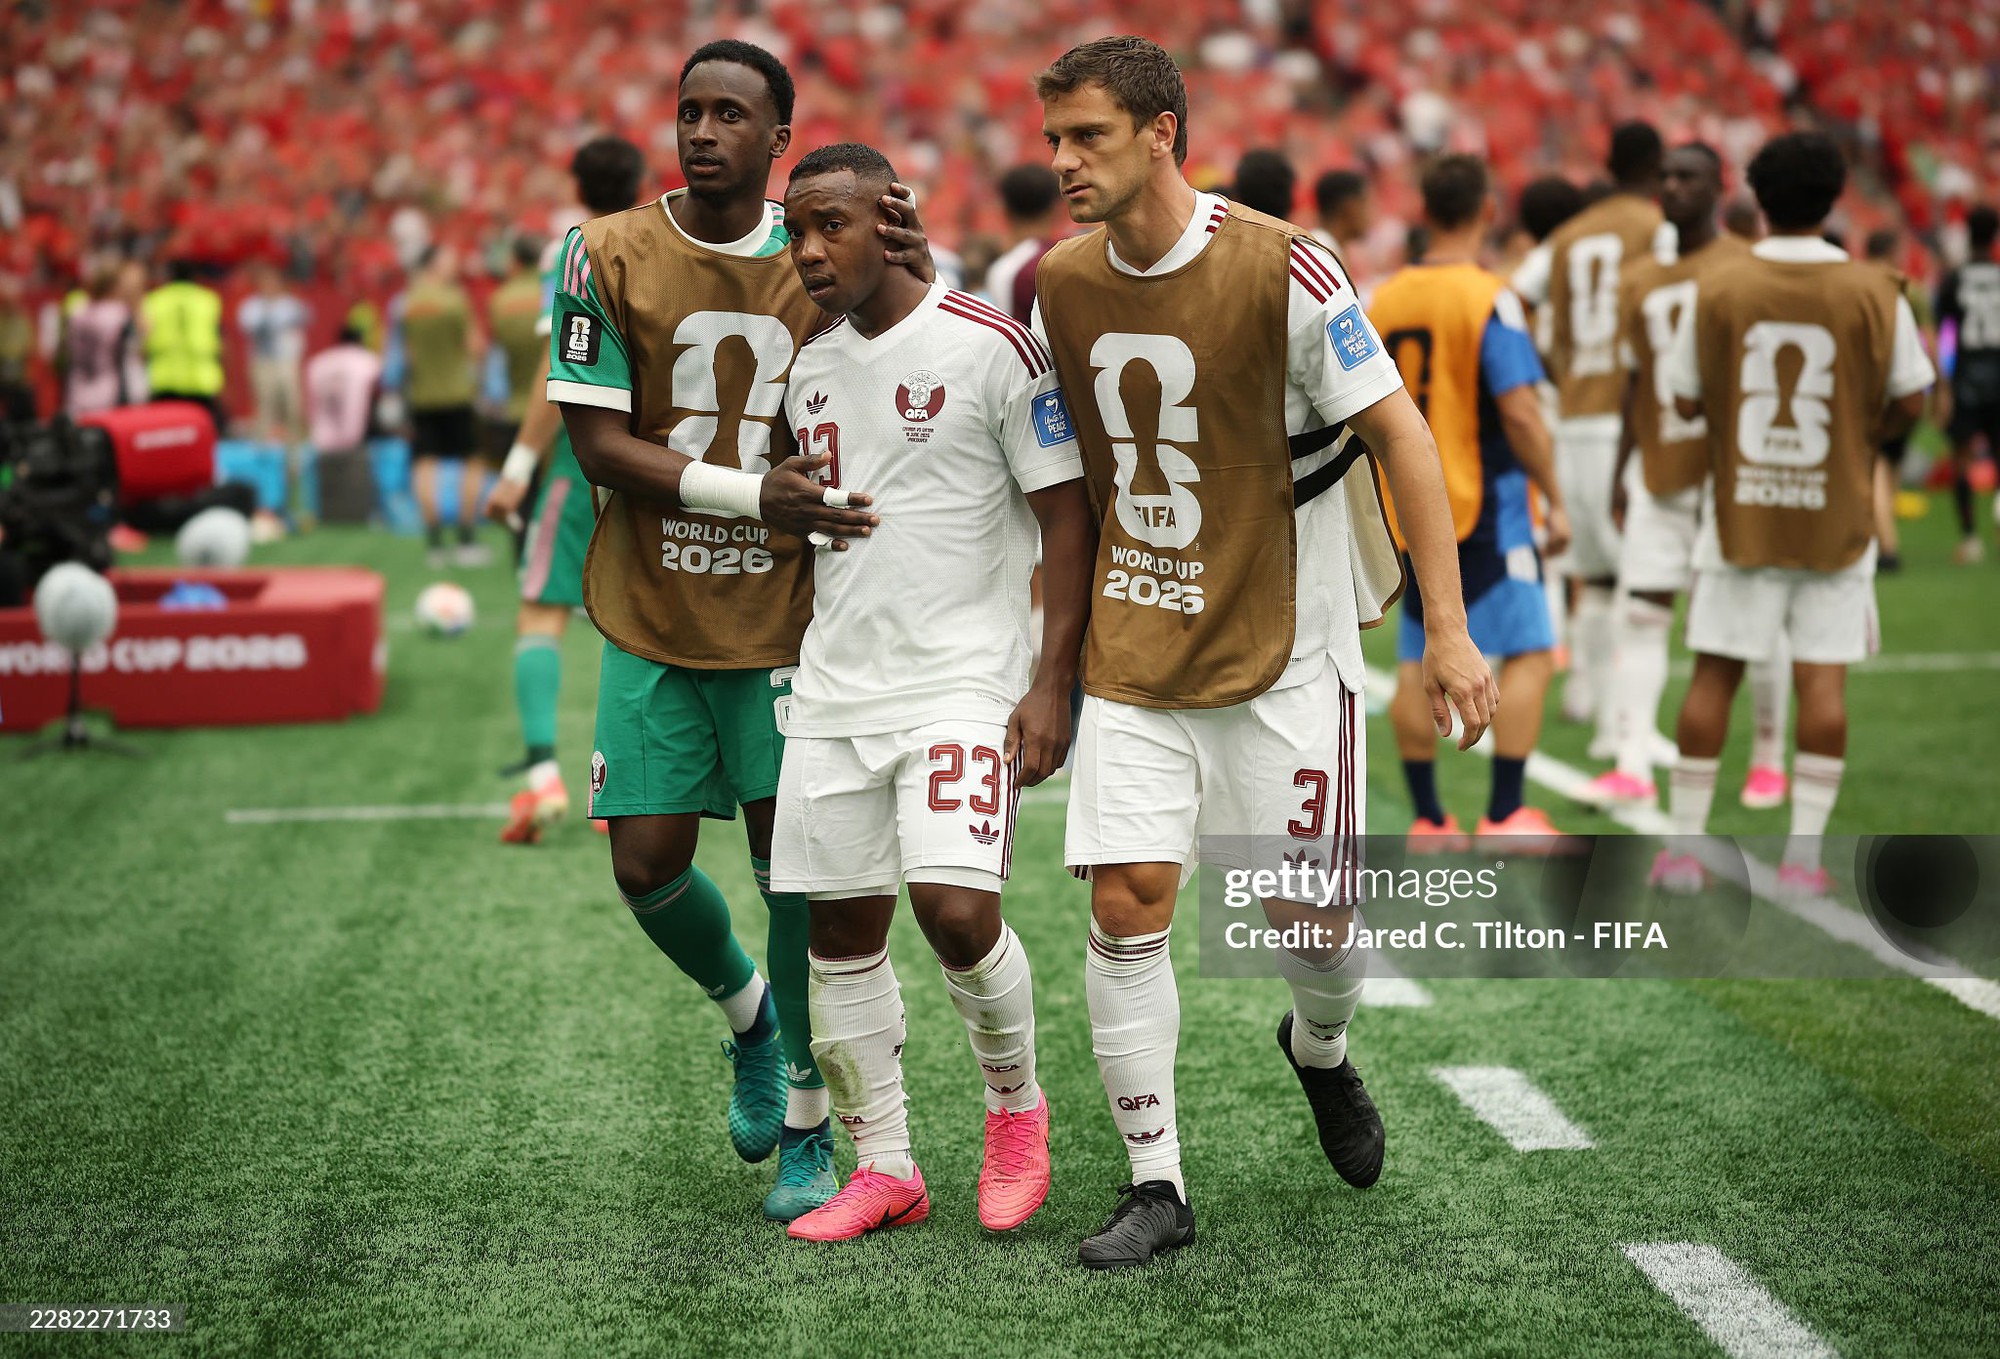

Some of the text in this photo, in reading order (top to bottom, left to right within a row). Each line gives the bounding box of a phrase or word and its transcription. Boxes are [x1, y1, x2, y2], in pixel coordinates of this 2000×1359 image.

[904, 408, 929, 419] QFA
[1733, 480, 1828, 510] 2026
[661, 517, 769, 545] WORLD CUP
[661, 541, 774, 575] 2026
[1102, 569, 1205, 615] 2026
[0, 633, 308, 675] WORD CUP 2026
[927, 743, 1005, 818] 23
[1287, 768, 1330, 843] 3
[1117, 1093, 1160, 1111] QFA
[835, 1113, 866, 1124] FA
